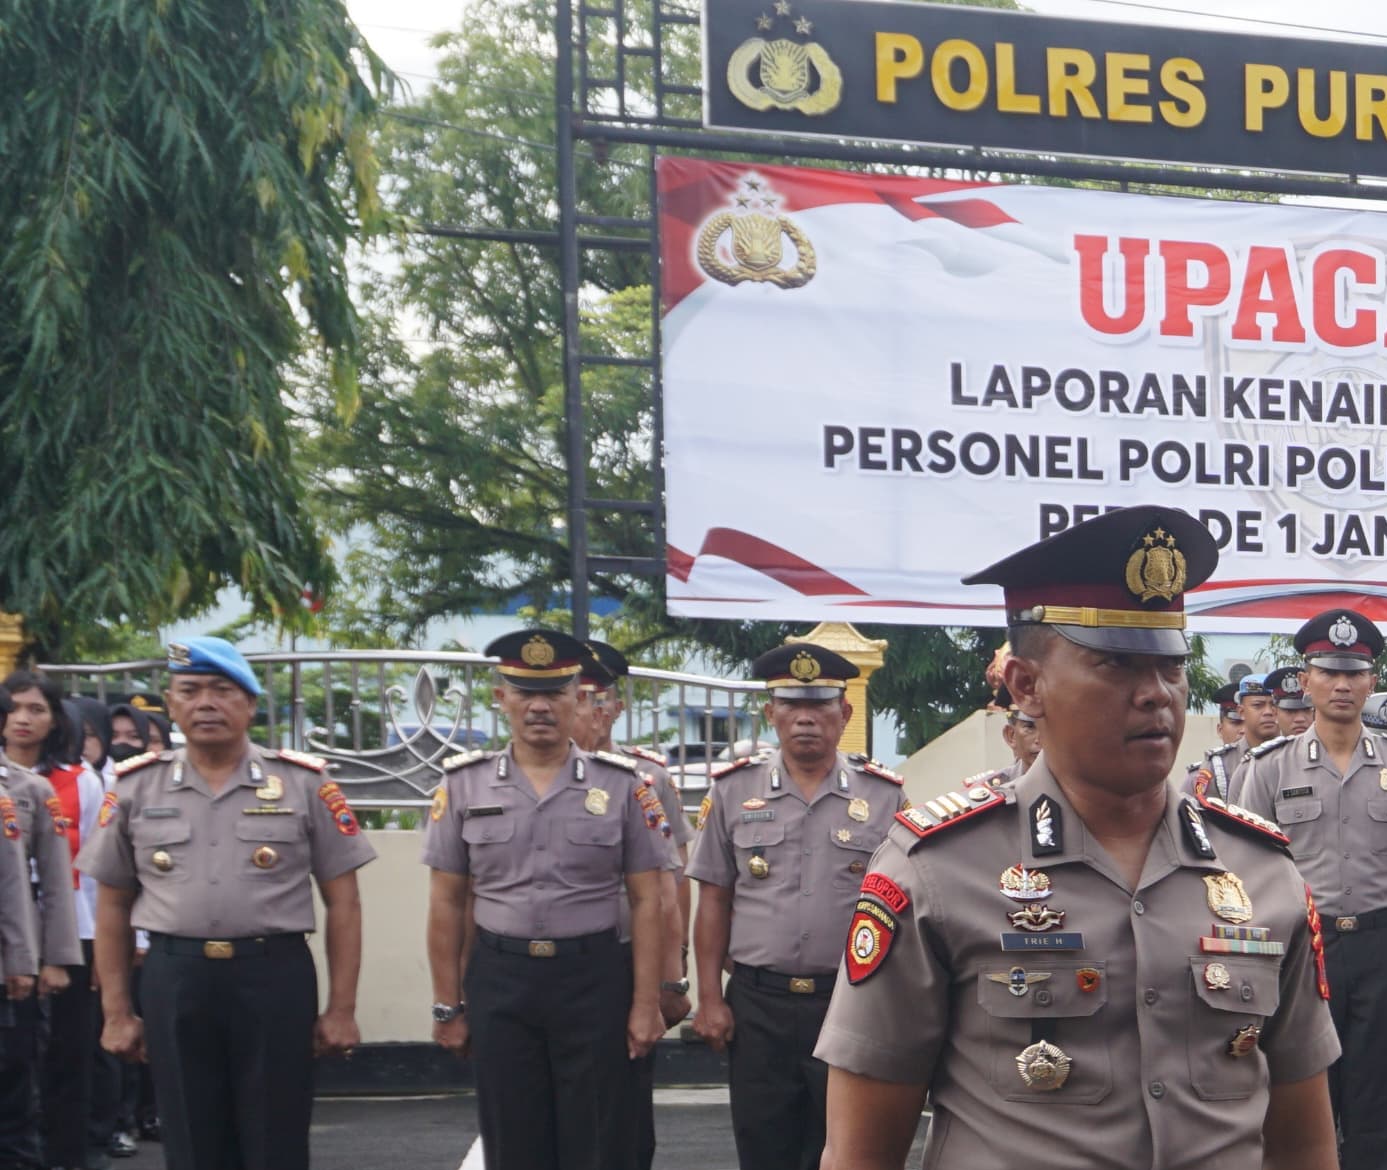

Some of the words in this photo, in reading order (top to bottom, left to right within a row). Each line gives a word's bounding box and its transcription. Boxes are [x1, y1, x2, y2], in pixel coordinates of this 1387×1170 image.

[875, 31, 1207, 129] POLRES
[950, 361, 1207, 418] LAPORAN
[823, 424, 1104, 481] PERSONEL
[1120, 438, 1270, 487] POLRI
[1277, 513, 1297, 554] 1
[864, 876, 902, 908] PELOPOR
